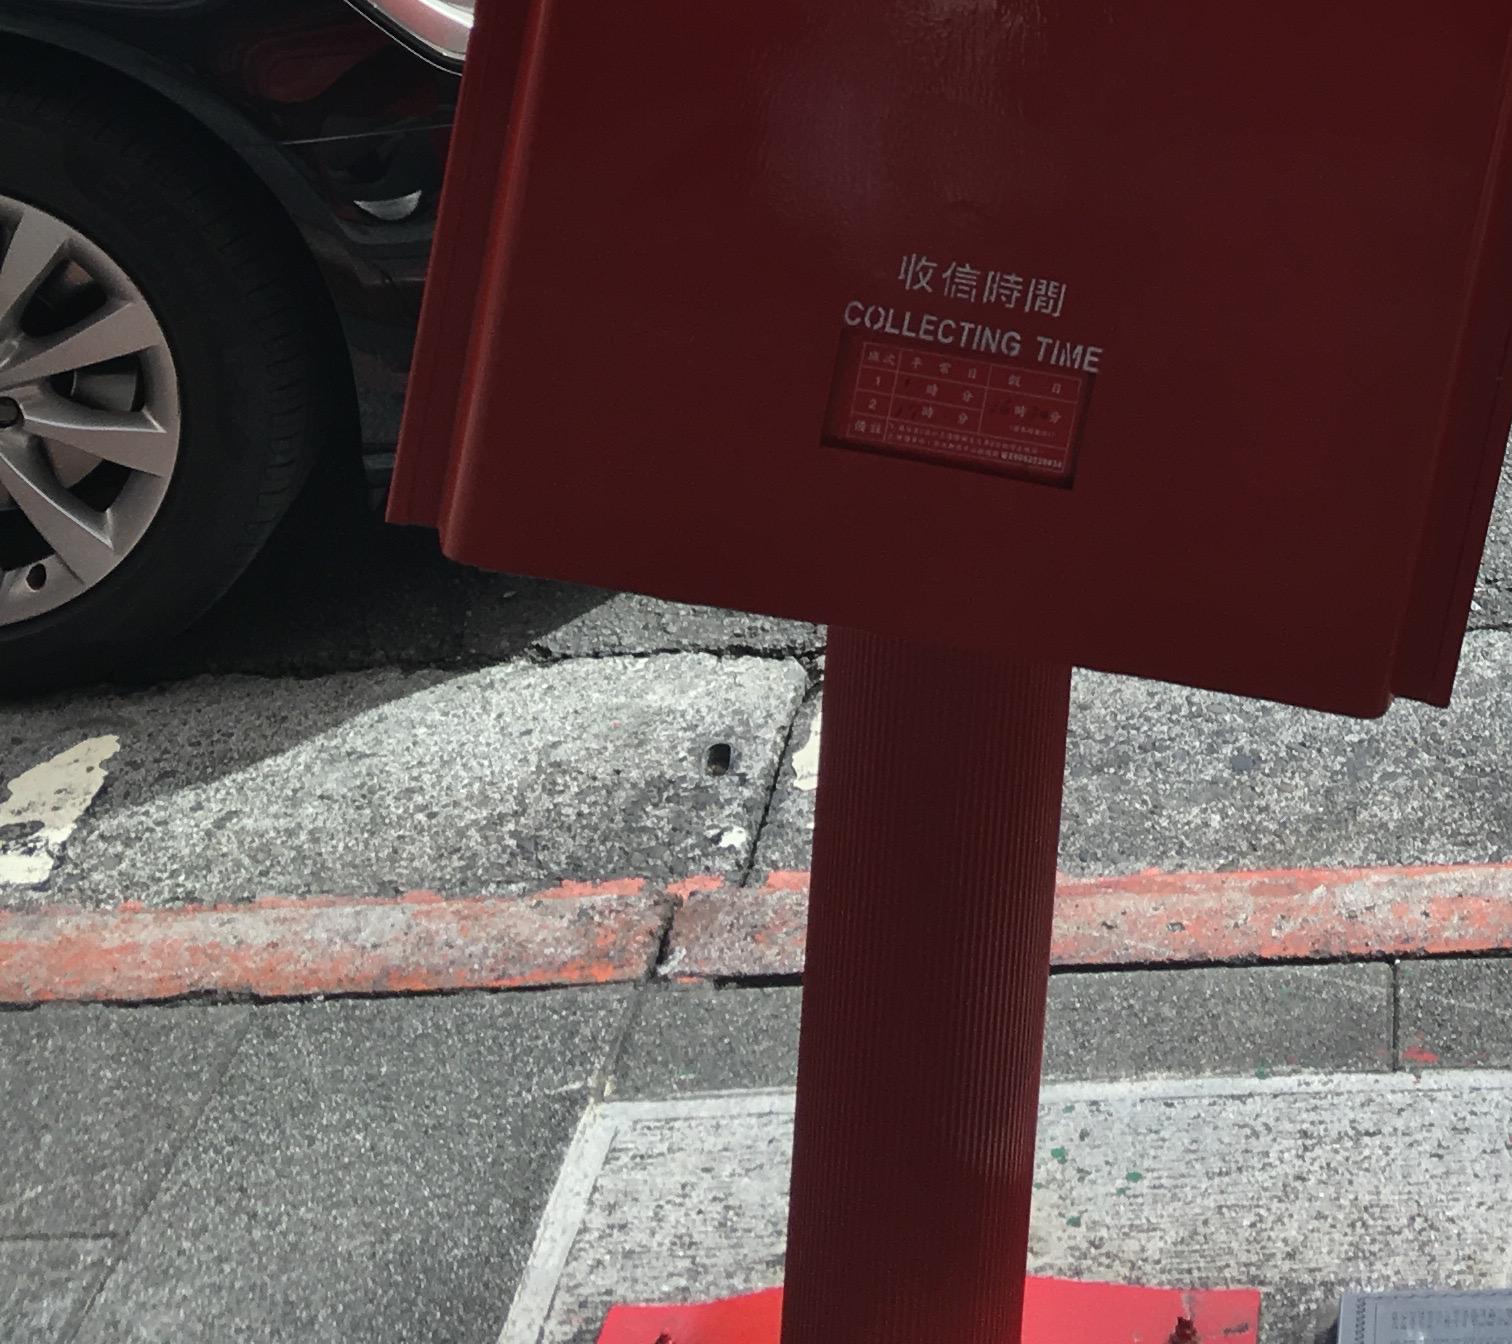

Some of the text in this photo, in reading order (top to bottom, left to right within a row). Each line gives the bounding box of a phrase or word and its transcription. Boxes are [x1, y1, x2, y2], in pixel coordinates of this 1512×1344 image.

[898, 253, 1067, 318] 收信時間
[844, 300, 1104, 373] COLLECTING TIME
